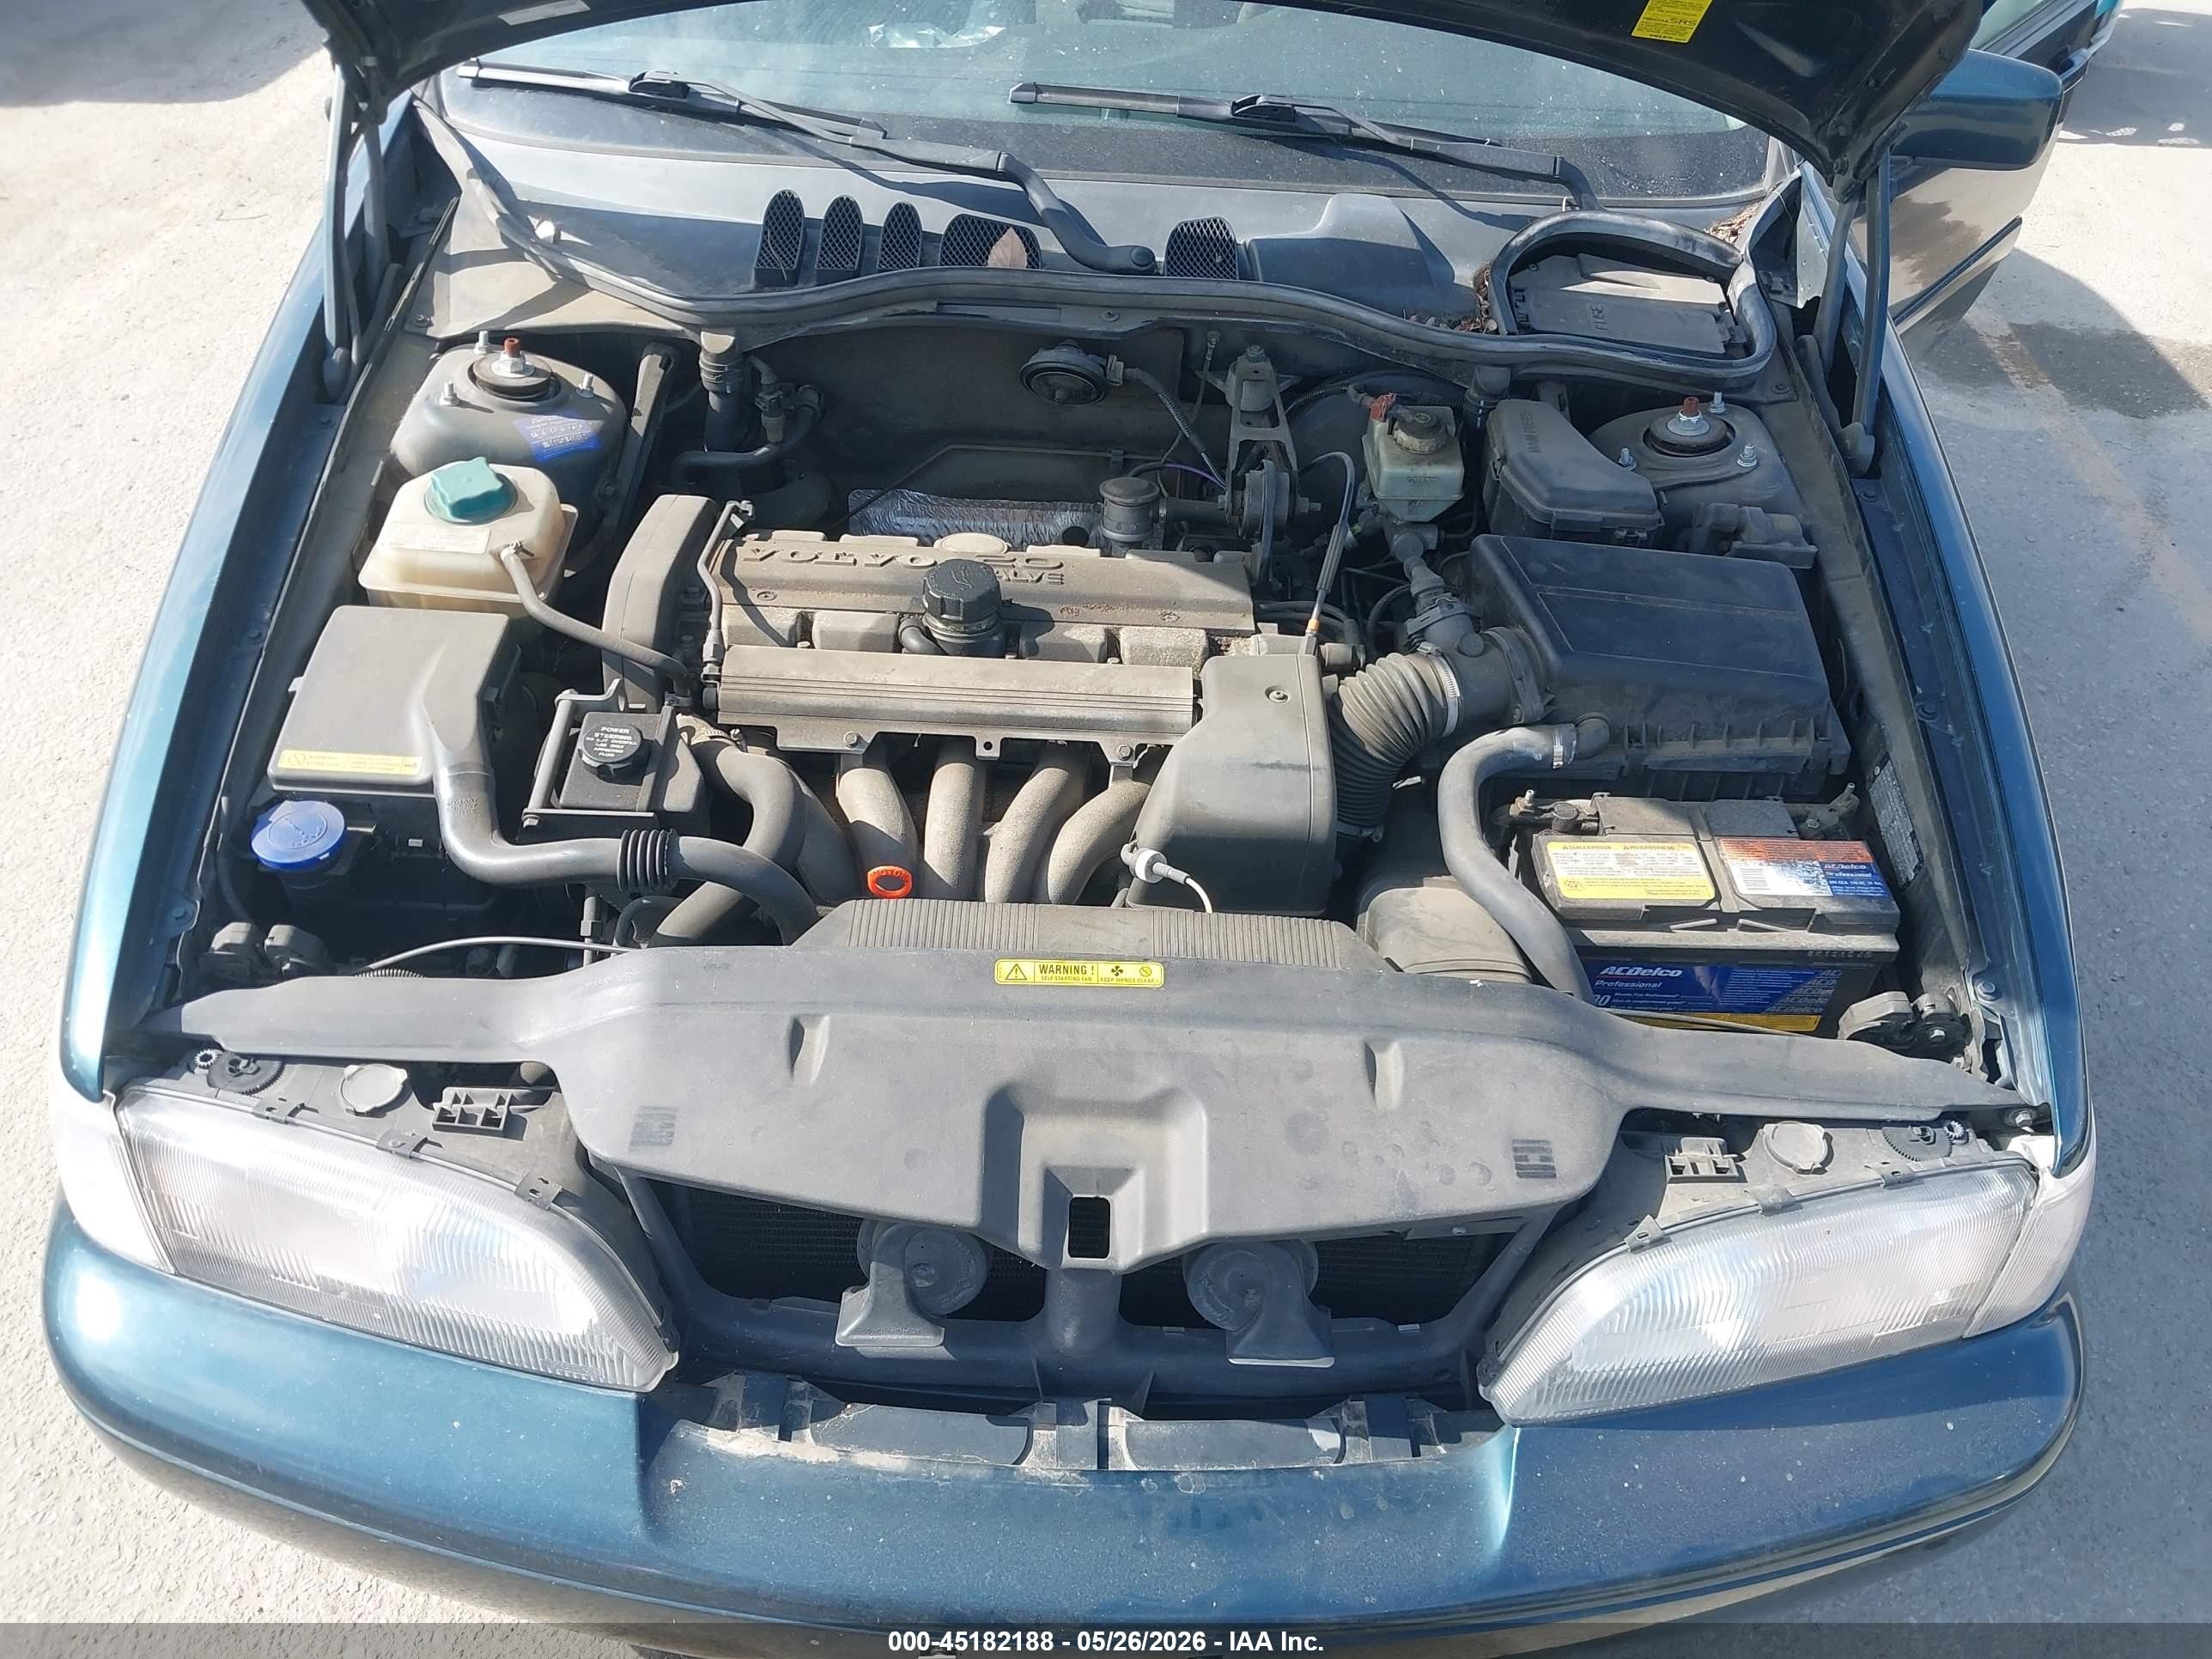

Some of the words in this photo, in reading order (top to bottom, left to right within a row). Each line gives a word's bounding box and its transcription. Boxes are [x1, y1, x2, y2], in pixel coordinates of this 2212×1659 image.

[744, 547, 938, 570] VOLVO
[995, 569, 1066, 586] ALVE
[1039, 964, 1087, 975] WARNING
[1600, 966, 1683, 977] ACDelco
[1594, 980, 1662, 988] Professional
